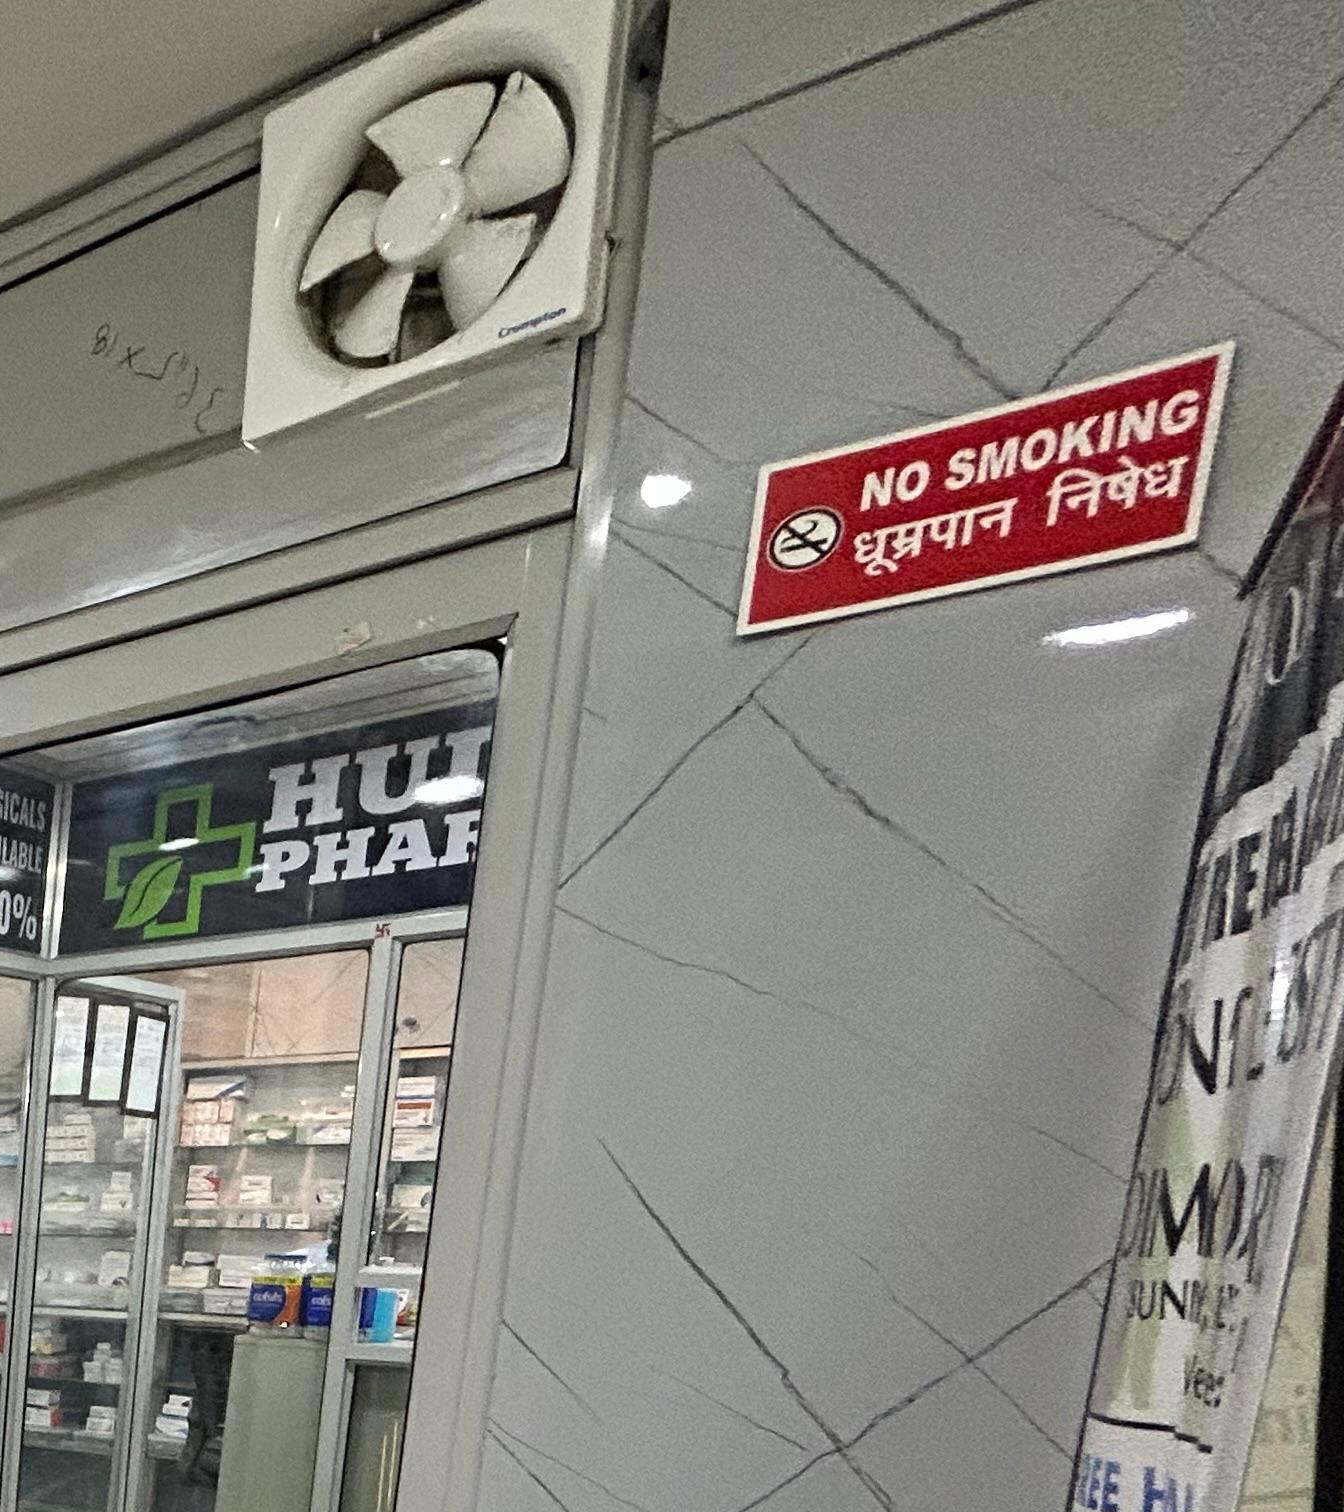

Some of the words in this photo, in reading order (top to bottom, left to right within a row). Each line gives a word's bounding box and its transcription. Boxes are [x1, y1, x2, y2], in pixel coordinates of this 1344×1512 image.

[498, 307, 567, 338] Crompton
[860, 460, 930, 512] NO
[944, 389, 1200, 491] SMOKING
[853, 496, 1018, 576] धूम्रपान
[1045, 454, 1188, 527] निषेध
